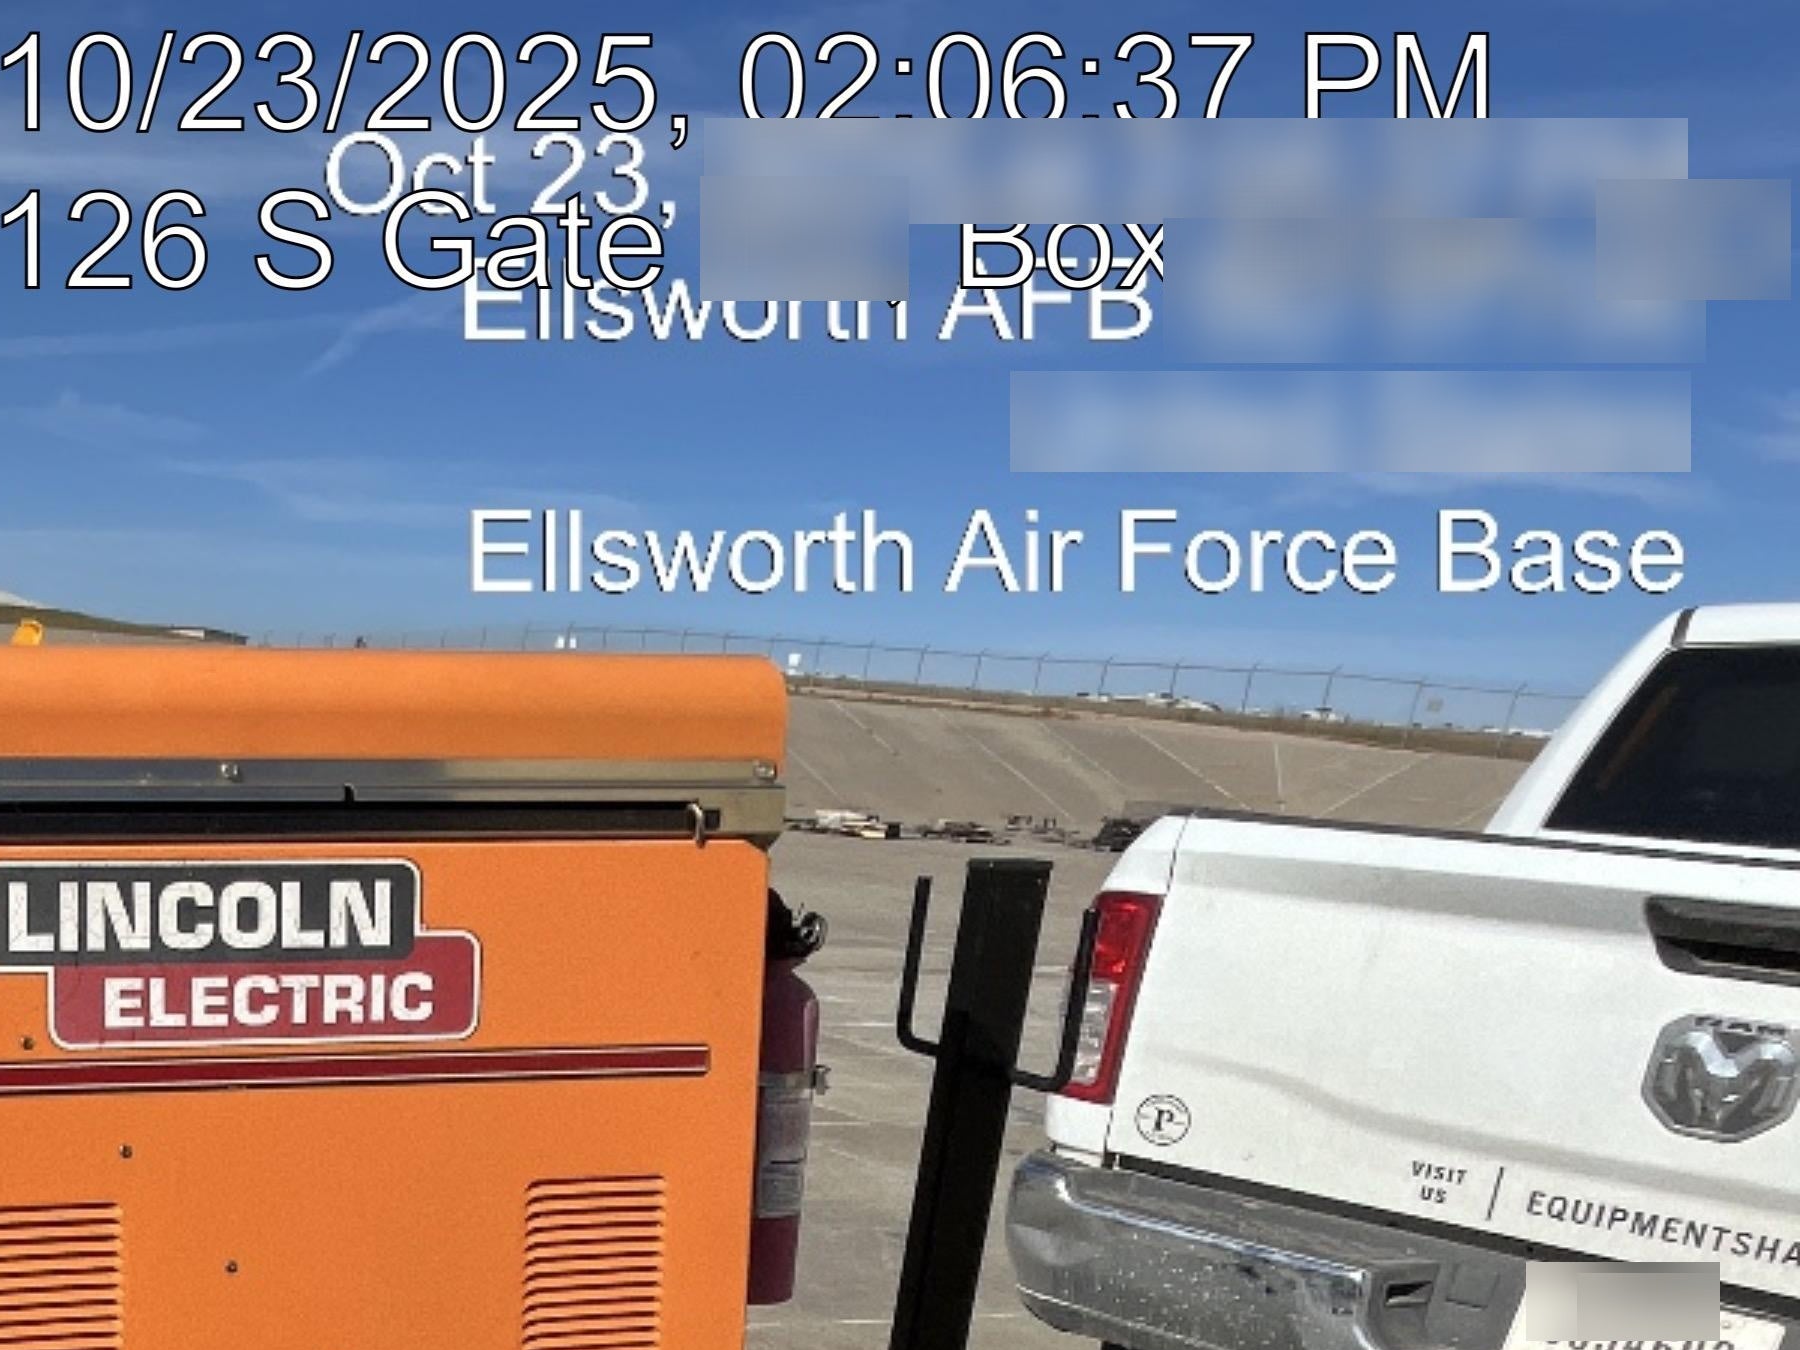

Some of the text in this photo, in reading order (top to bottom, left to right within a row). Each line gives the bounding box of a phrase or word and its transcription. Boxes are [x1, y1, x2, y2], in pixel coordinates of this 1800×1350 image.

[7, 879, 392, 953] LINCOLN
[103, 971, 434, 1028] ELECTRIC
[1411, 1160, 1468, 1185] VISIT
[1420, 1185, 1447, 1204] US
